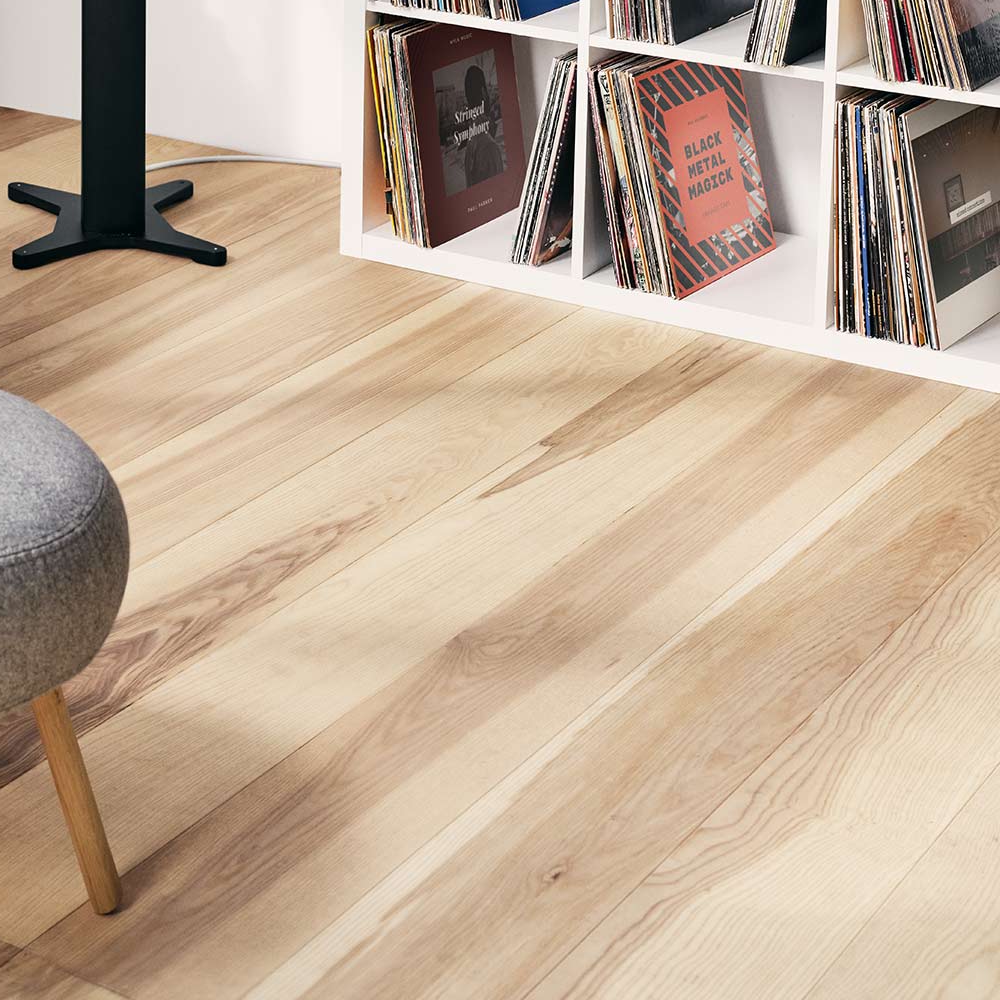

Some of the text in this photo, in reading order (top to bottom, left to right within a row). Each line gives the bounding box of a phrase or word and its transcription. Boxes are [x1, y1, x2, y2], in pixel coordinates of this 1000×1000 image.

[454, 100, 485, 125] Stringed
[453, 120, 490, 146] Symphony
[684, 131, 722, 160] BLACK
[687, 151, 726, 180] METAL
[687, 166, 734, 201] MAGICK
